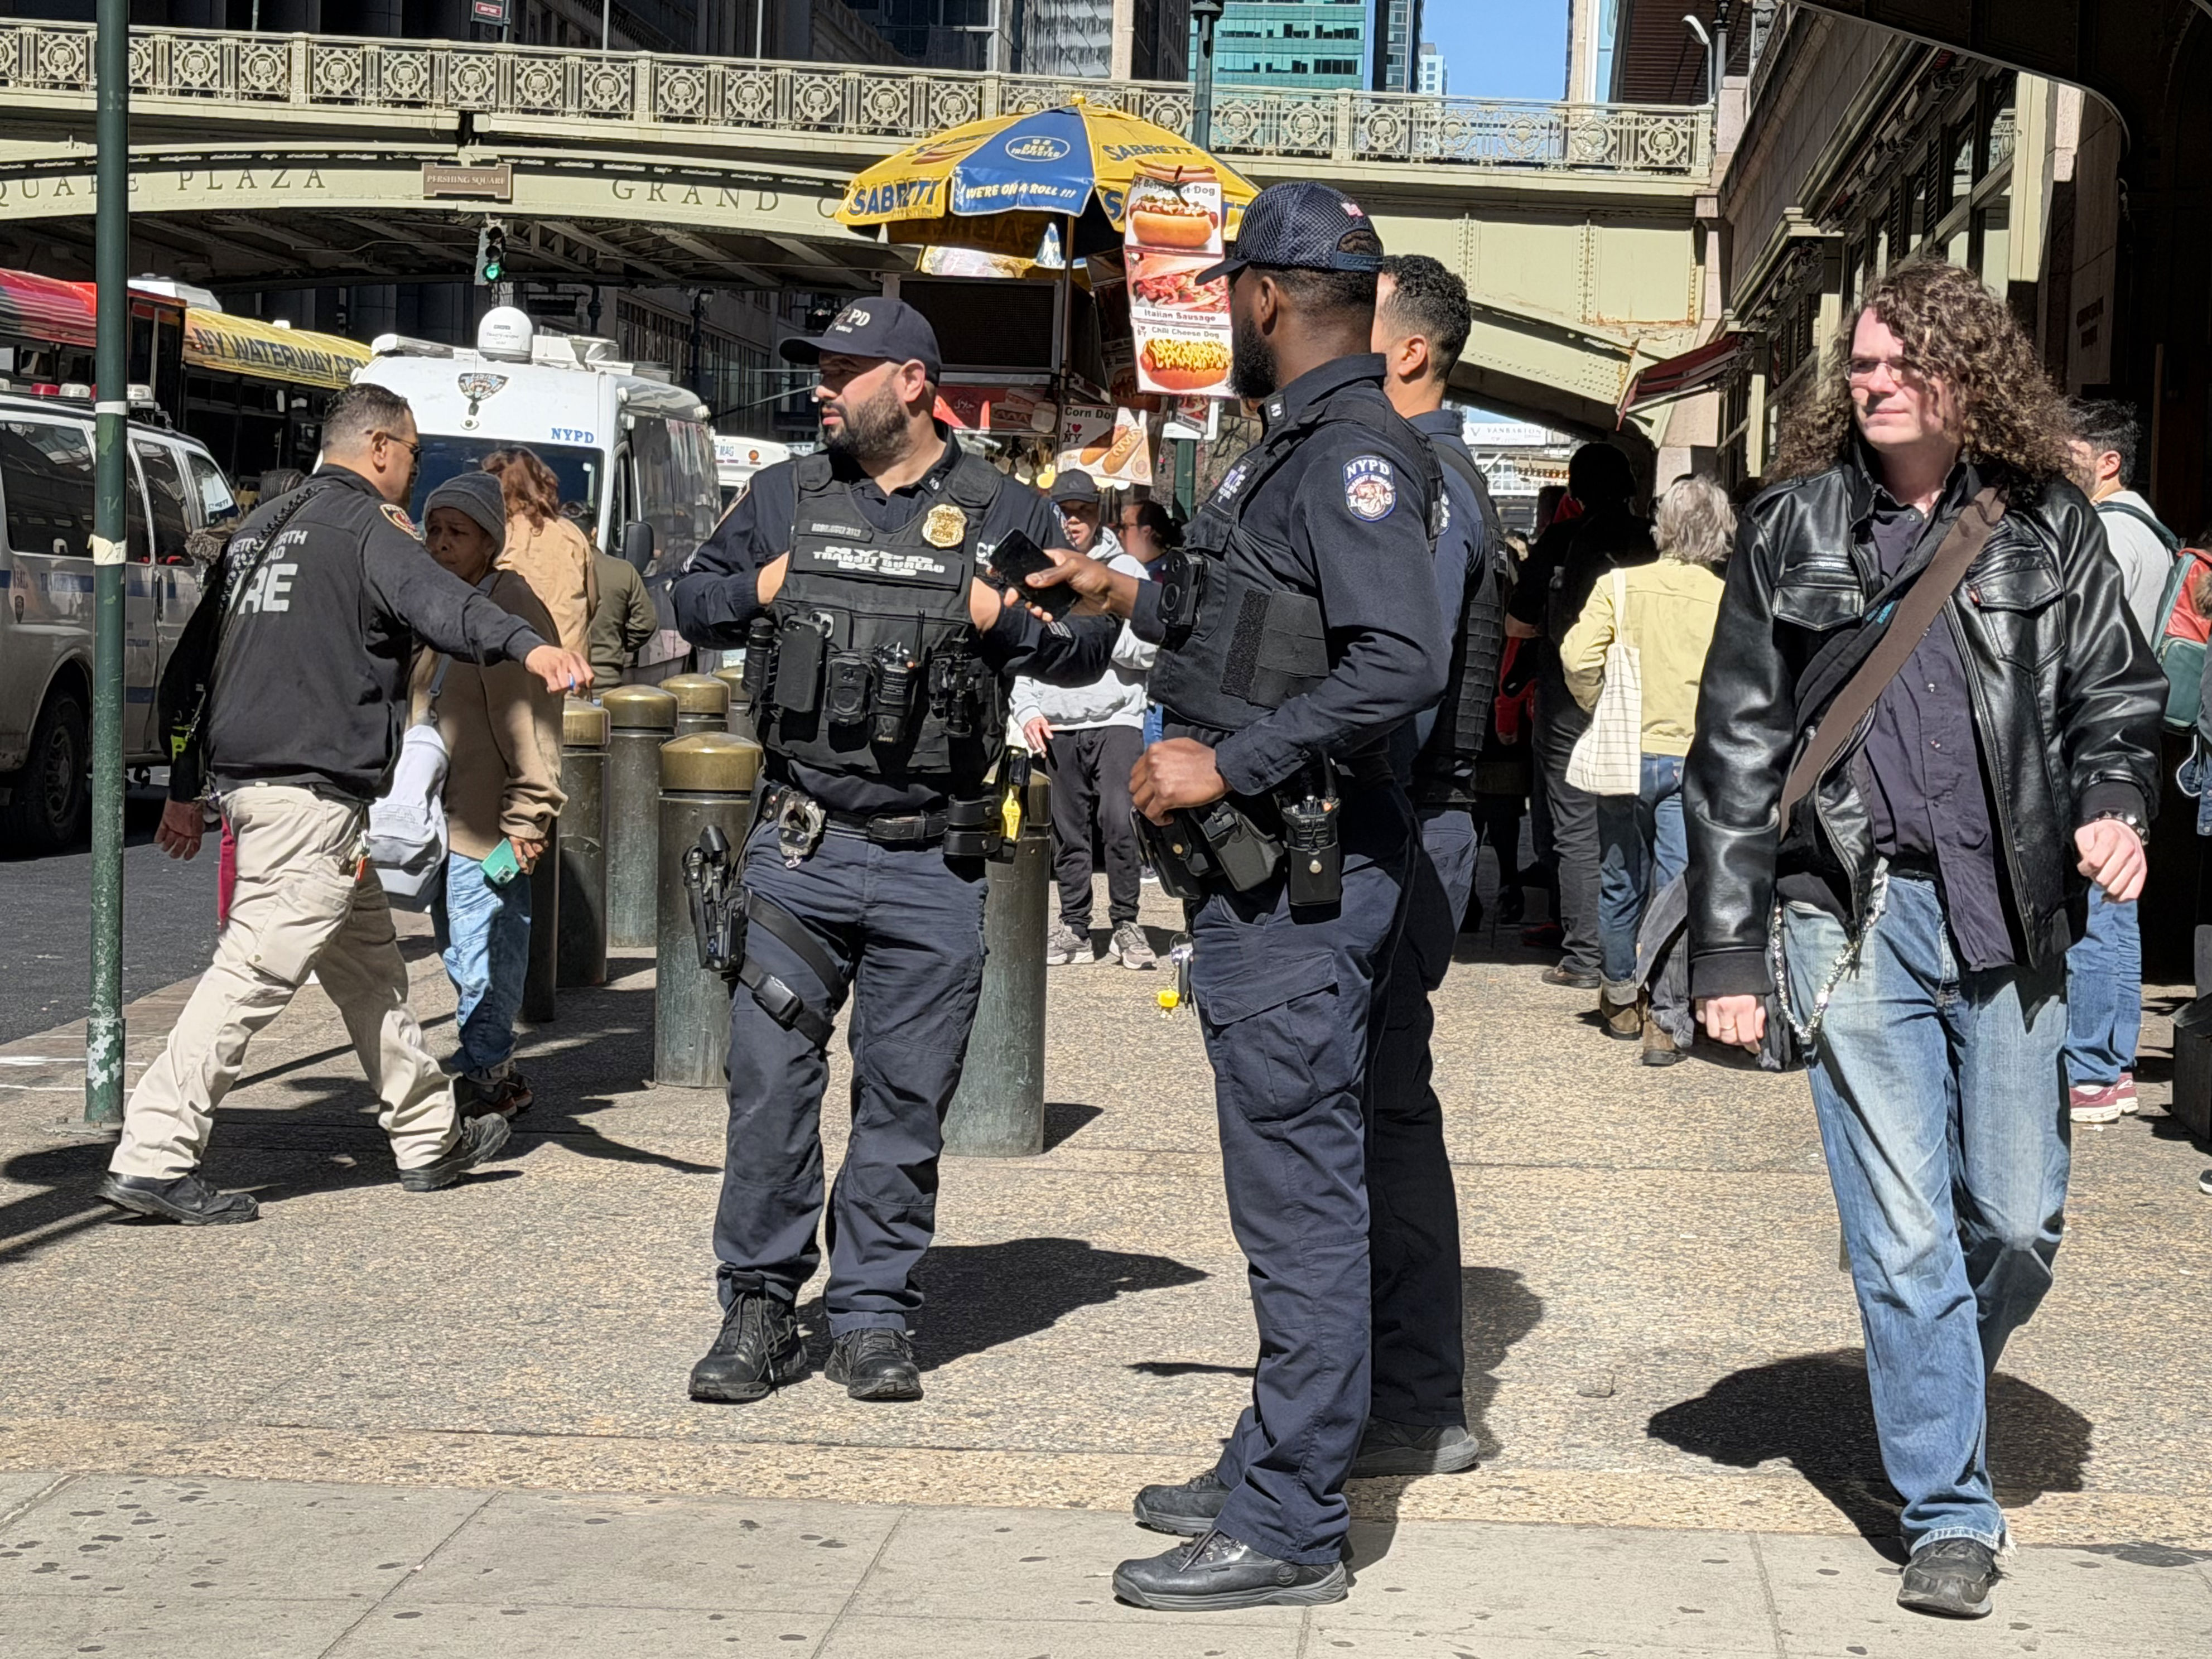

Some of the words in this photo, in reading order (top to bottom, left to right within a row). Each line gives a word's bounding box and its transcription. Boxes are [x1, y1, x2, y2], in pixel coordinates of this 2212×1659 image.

[178, 168, 326, 191] PLAZA
[427, 175, 470, 184] PERSHING
[472, 177, 505, 185] SQUARE
[611, 179, 779, 211] GRAND
[1001, 183, 1018, 195] ON
[1019, 183, 1028, 194] A
[1030, 184, 1058, 195] ROLL
[1194, 185, 1215, 197] Dog
[1144, 308, 1173, 319] Italian
[1176, 312, 1216, 323] Sausage
[1172, 328, 1201, 337] Cheese
[1203, 331, 1220, 340] Dog
[1065, 406, 1092, 418] Corn
[551, 427, 595, 444] NYPD
[1063, 433, 1083, 444] NY
[1346, 459, 1391, 479] NYPD
[812, 551, 880, 565] TRANSIT
[881, 560, 946, 573] BUREAU
